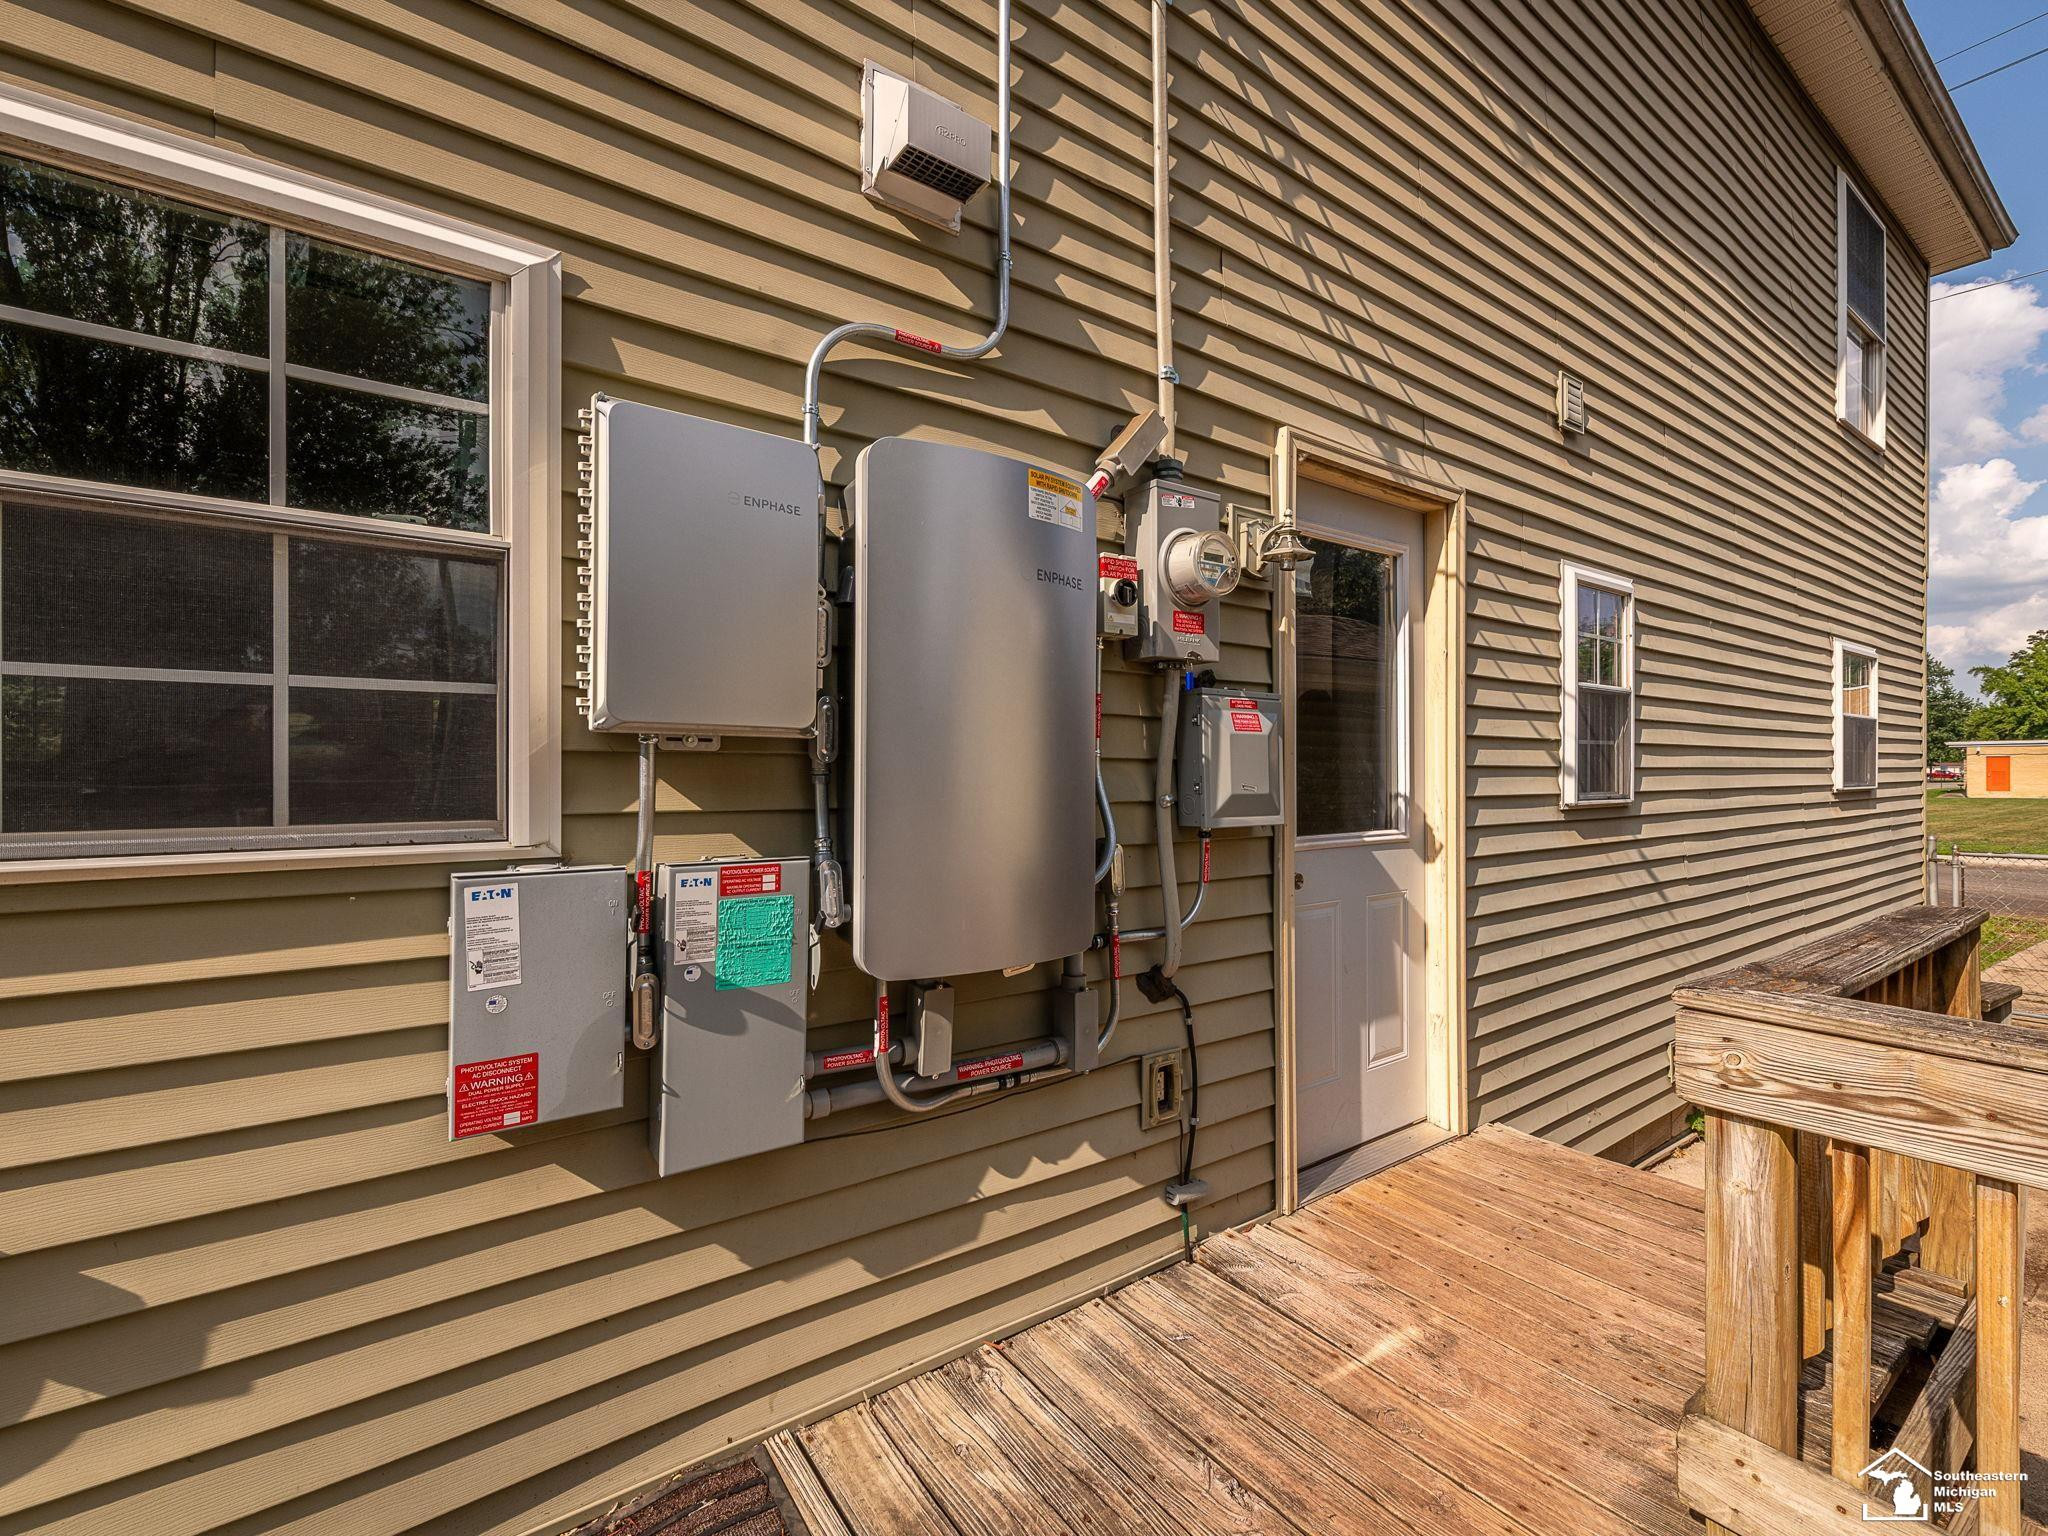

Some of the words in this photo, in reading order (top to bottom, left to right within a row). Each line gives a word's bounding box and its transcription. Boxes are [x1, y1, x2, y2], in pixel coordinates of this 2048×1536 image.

[744, 495, 801, 516] ENPHASE
[1037, 568, 1083, 590] ENPHASE
[826, 1052, 864, 1062] PHOTOVOLTAIC
[846, 1058, 867, 1066] SOURCE
[984, 1054, 1022, 1067] PHOTOVOLTAIC
[460, 1060, 508, 1075] PHOTOVOLTAIC
[508, 1057, 533, 1066] SYSTEM
[482, 1065, 522, 1078] DISCONNECT
[970, 1067, 990, 1077] POWER
[991, 1062, 1012, 1073] SOURCE
[468, 1089, 483, 1097] DUAL
[483, 1085, 504, 1094] POWER
[505, 1082, 526, 1091] SUPPLY
[470, 1073, 523, 1091] WARNING
[461, 1100, 489, 1109] ELECTRIC
[489, 1095, 509, 1104] SHOCK
[509, 1091, 532, 1100] HAZARD
